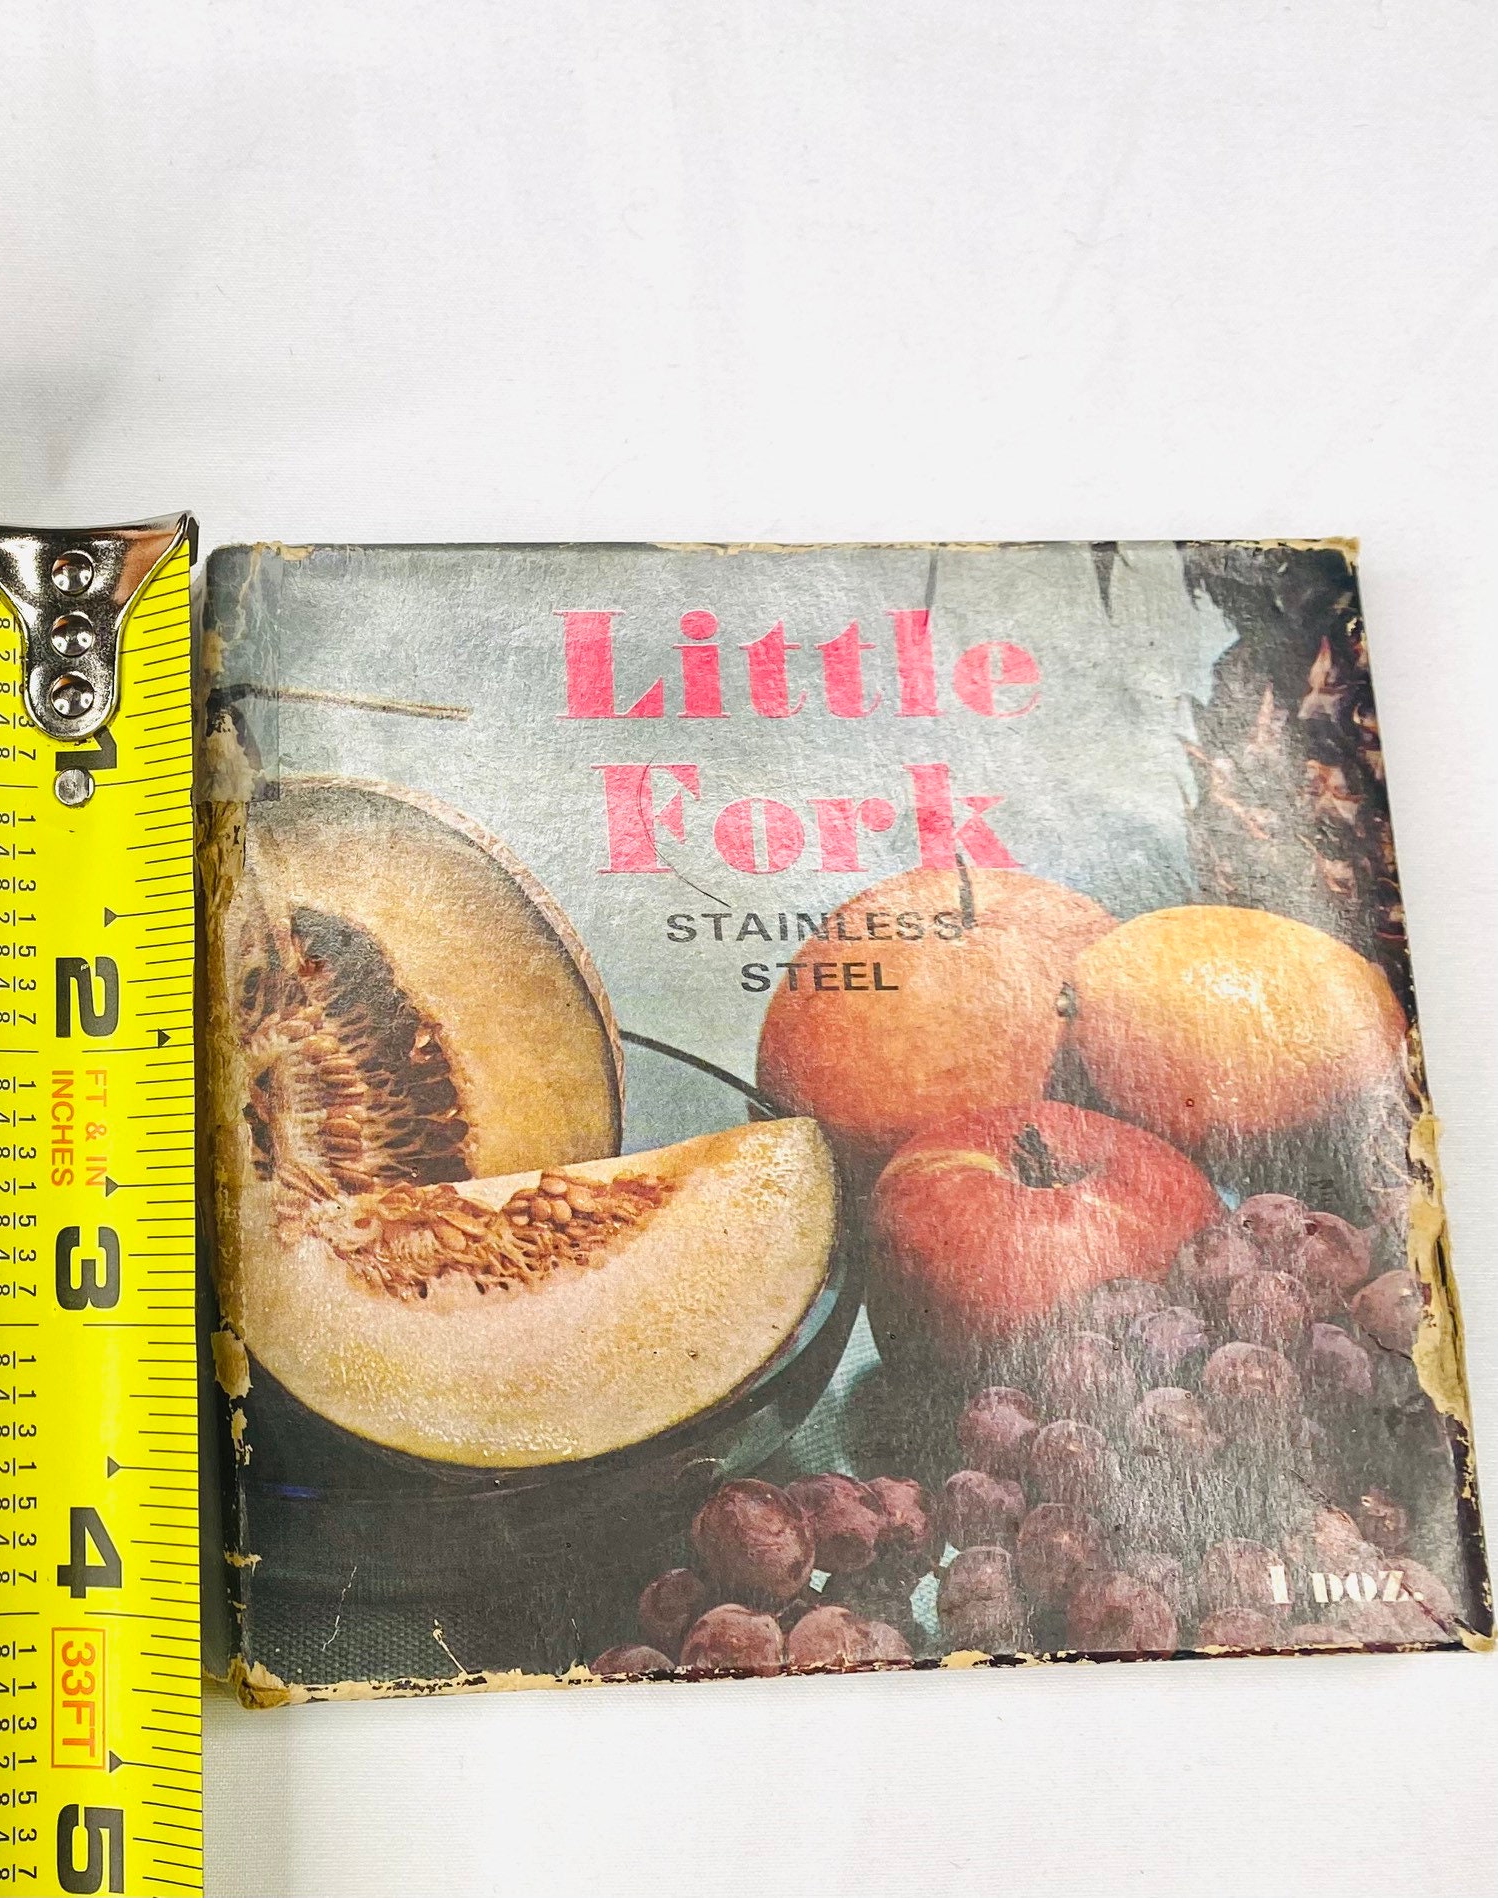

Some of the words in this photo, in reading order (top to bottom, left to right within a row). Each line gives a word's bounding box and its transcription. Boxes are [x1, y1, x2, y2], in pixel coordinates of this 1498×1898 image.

[552, 607, 1042, 721] Little
[55, 725, 118, 772] 1
[592, 762, 1023, 875] Fork
[665, 911, 964, 944] STAINLESS
[55, 956, 120, 1039] 2
[740, 961, 900, 993] STEEL
[50, 1069, 75, 1188] INCHES
[85, 1069, 108, 1107] FT
[84, 1156, 108, 1187] IN
[85, 1121, 108, 1142] &
[55, 1225, 121, 1311] 3
[57, 1506, 123, 1600] 4
[61, 1640, 96, 1758] 33FT
[57, 1803, 124, 1895] 5
